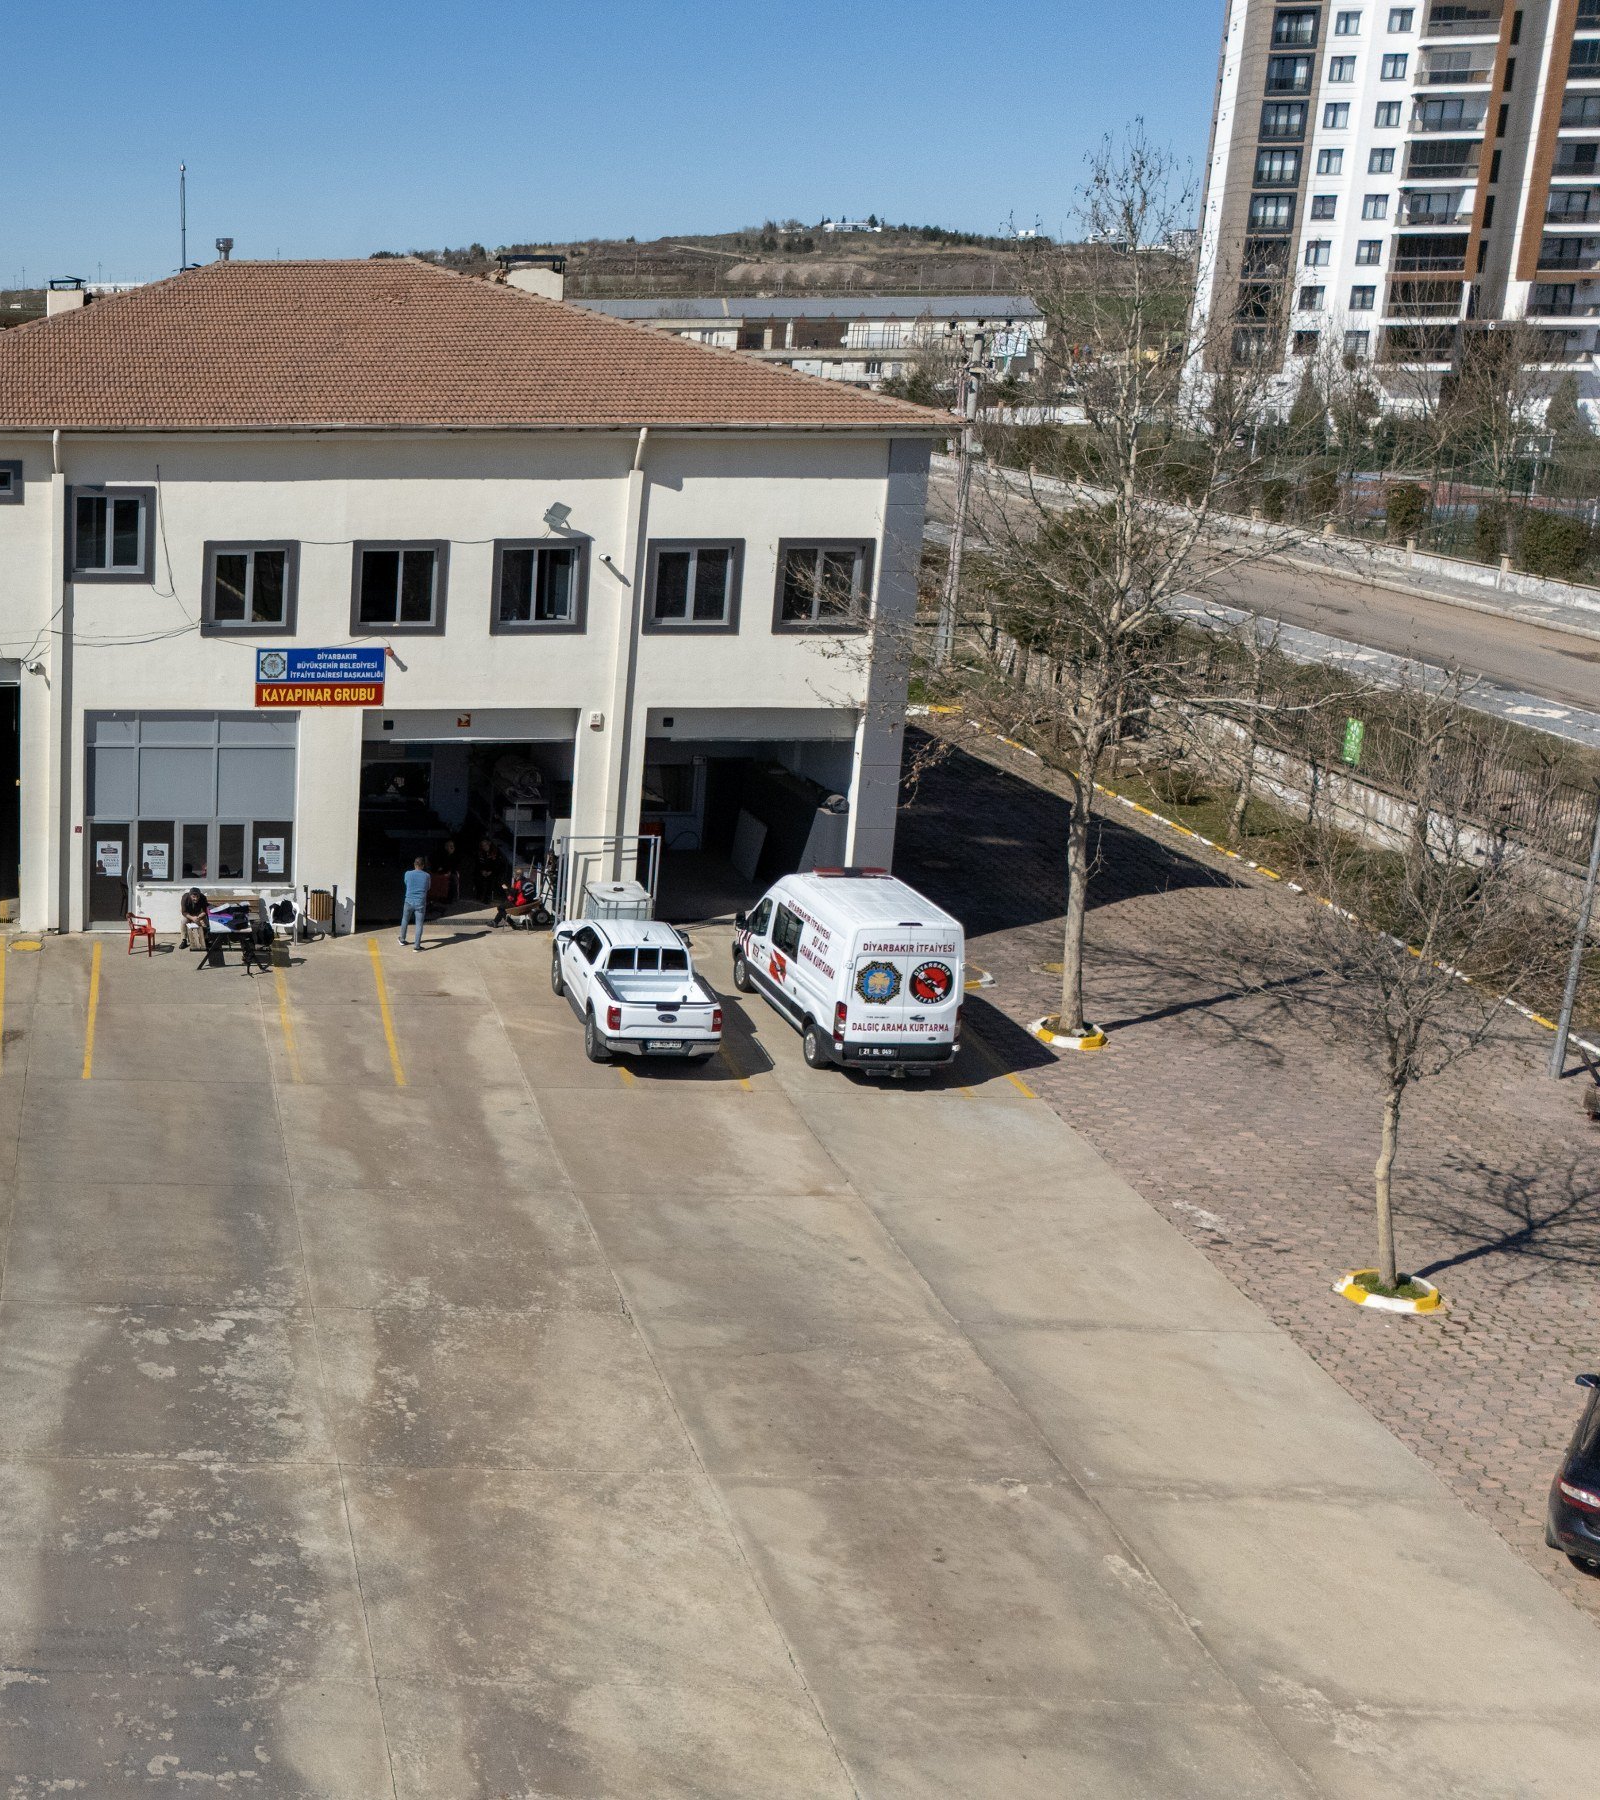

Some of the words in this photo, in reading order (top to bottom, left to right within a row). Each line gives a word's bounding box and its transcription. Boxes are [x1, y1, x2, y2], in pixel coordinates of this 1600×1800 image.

[317, 652, 357, 660] DİYARBAKIR
[296, 661, 339, 670] BÜYÜKŞEHİR
[340, 661, 378, 669] BELEDİYESİ
[290, 671, 316, 679] İTFAİYE
[316, 671, 343, 679] DAİRESİ
[344, 671, 384, 680] BAŞKANLIĞI
[262, 688, 332, 702] KAYAPINAR
[334, 687, 376, 701] GRUBU
[787, 900, 811, 923] DİYARBAKIR
[810, 917, 832, 941] İTFAİYESİ
[811, 935, 820, 948] SU
[817, 941, 829, 956] ALTI
[863, 941, 914, 952] DİYARBAKIR
[916, 942, 956, 953] İTFAİYESİ
[800, 944, 814, 961] ARAMA
[812, 954, 836, 980] KURTARMA
[914, 962, 951, 976] DİYARBAKIR
[852, 1022, 880, 1032] DALGIÇ
[881, 1023, 907, 1032] ARAMA
[909, 1023, 949, 1032] KURTARMA
